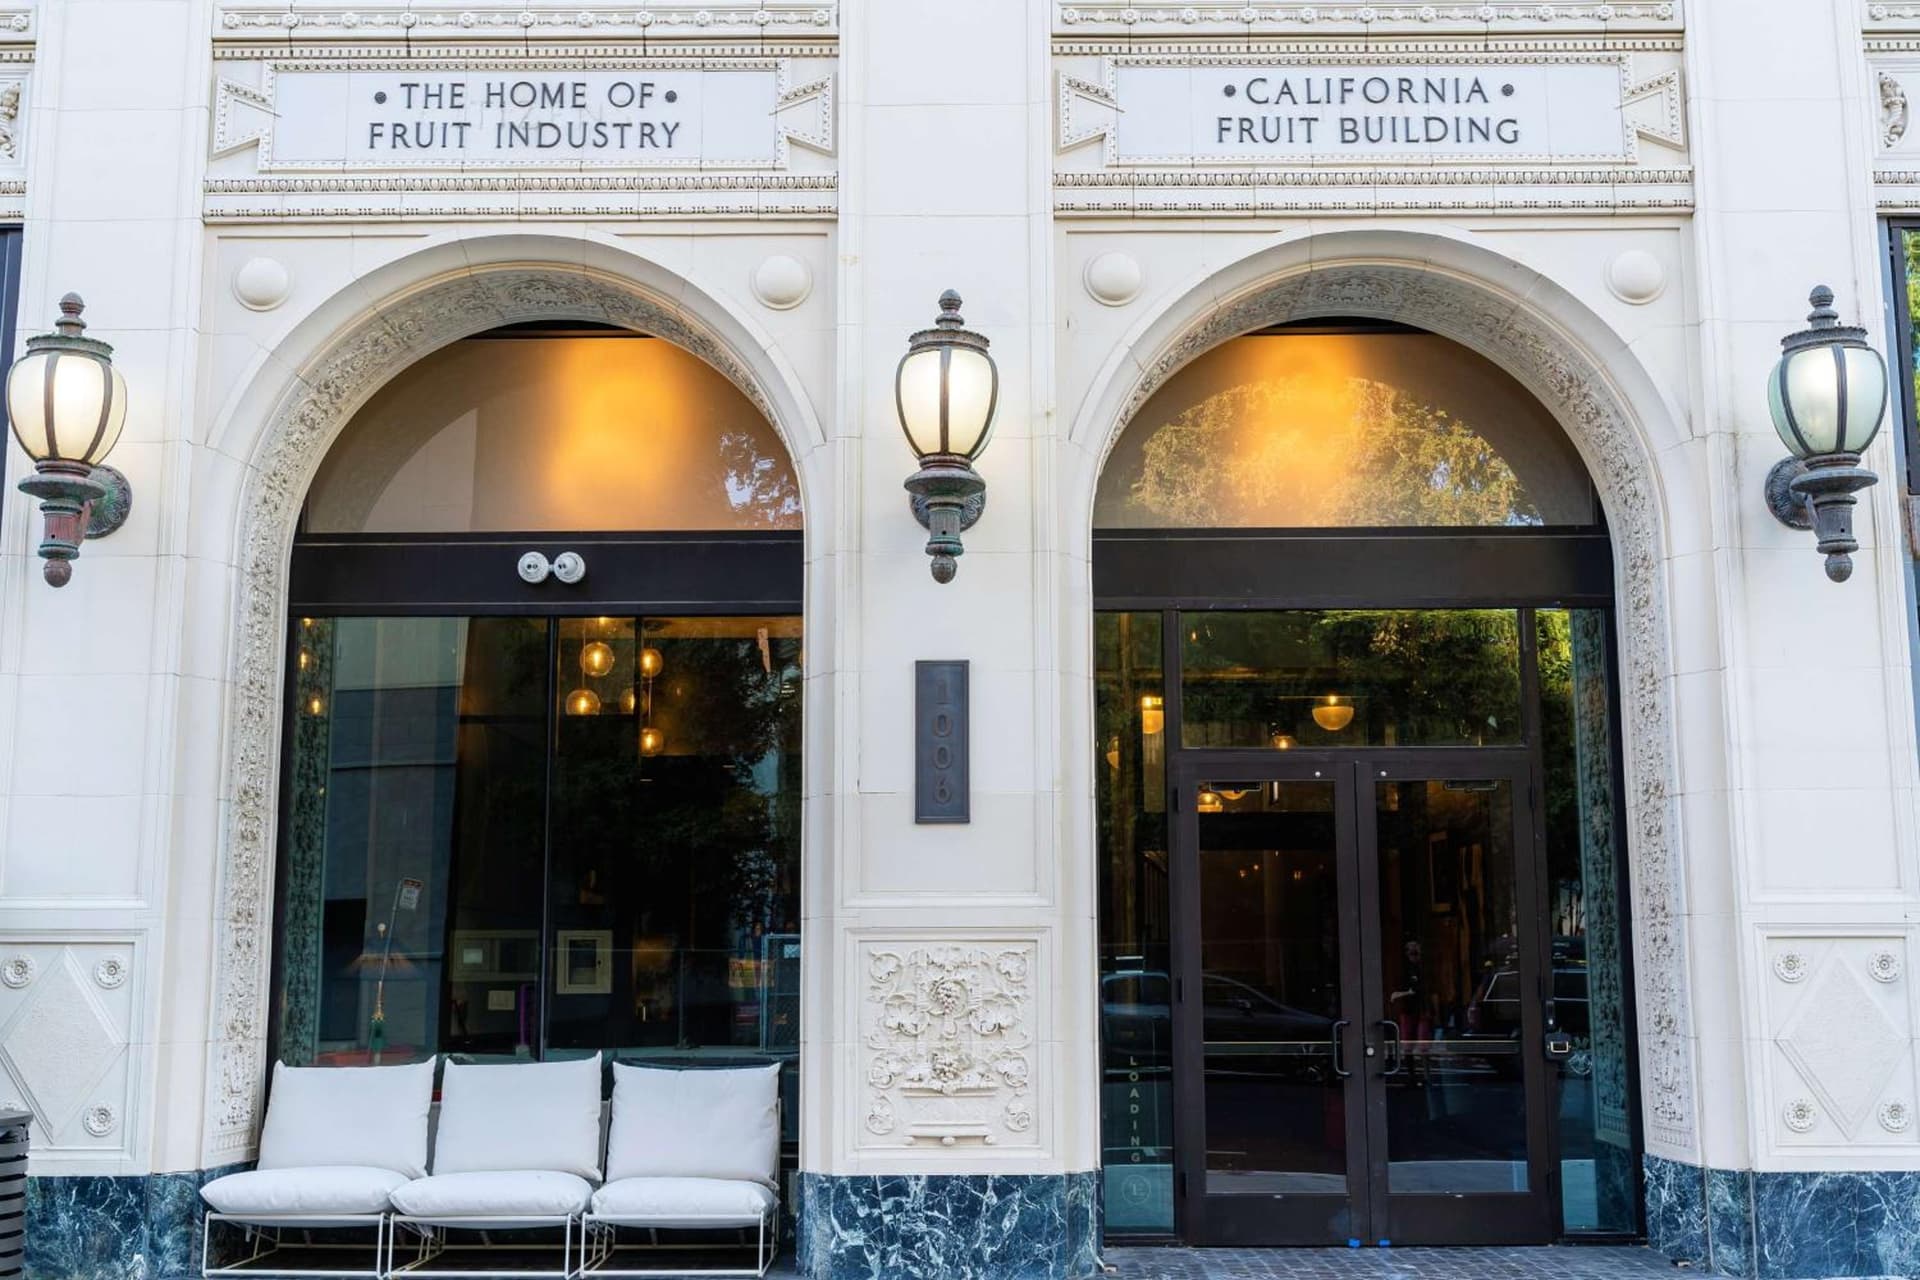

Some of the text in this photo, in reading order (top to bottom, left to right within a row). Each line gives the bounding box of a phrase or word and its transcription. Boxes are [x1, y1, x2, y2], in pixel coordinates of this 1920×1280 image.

[400, 81, 655, 109] THE HOME OF
[1246, 76, 1490, 105] CALIFORNIA
[368, 121, 680, 149] FRUIT INDUSTRY
[1217, 116, 1520, 144] FRUIT BUILDING
[1129, 1055, 1141, 1163] LOADING
